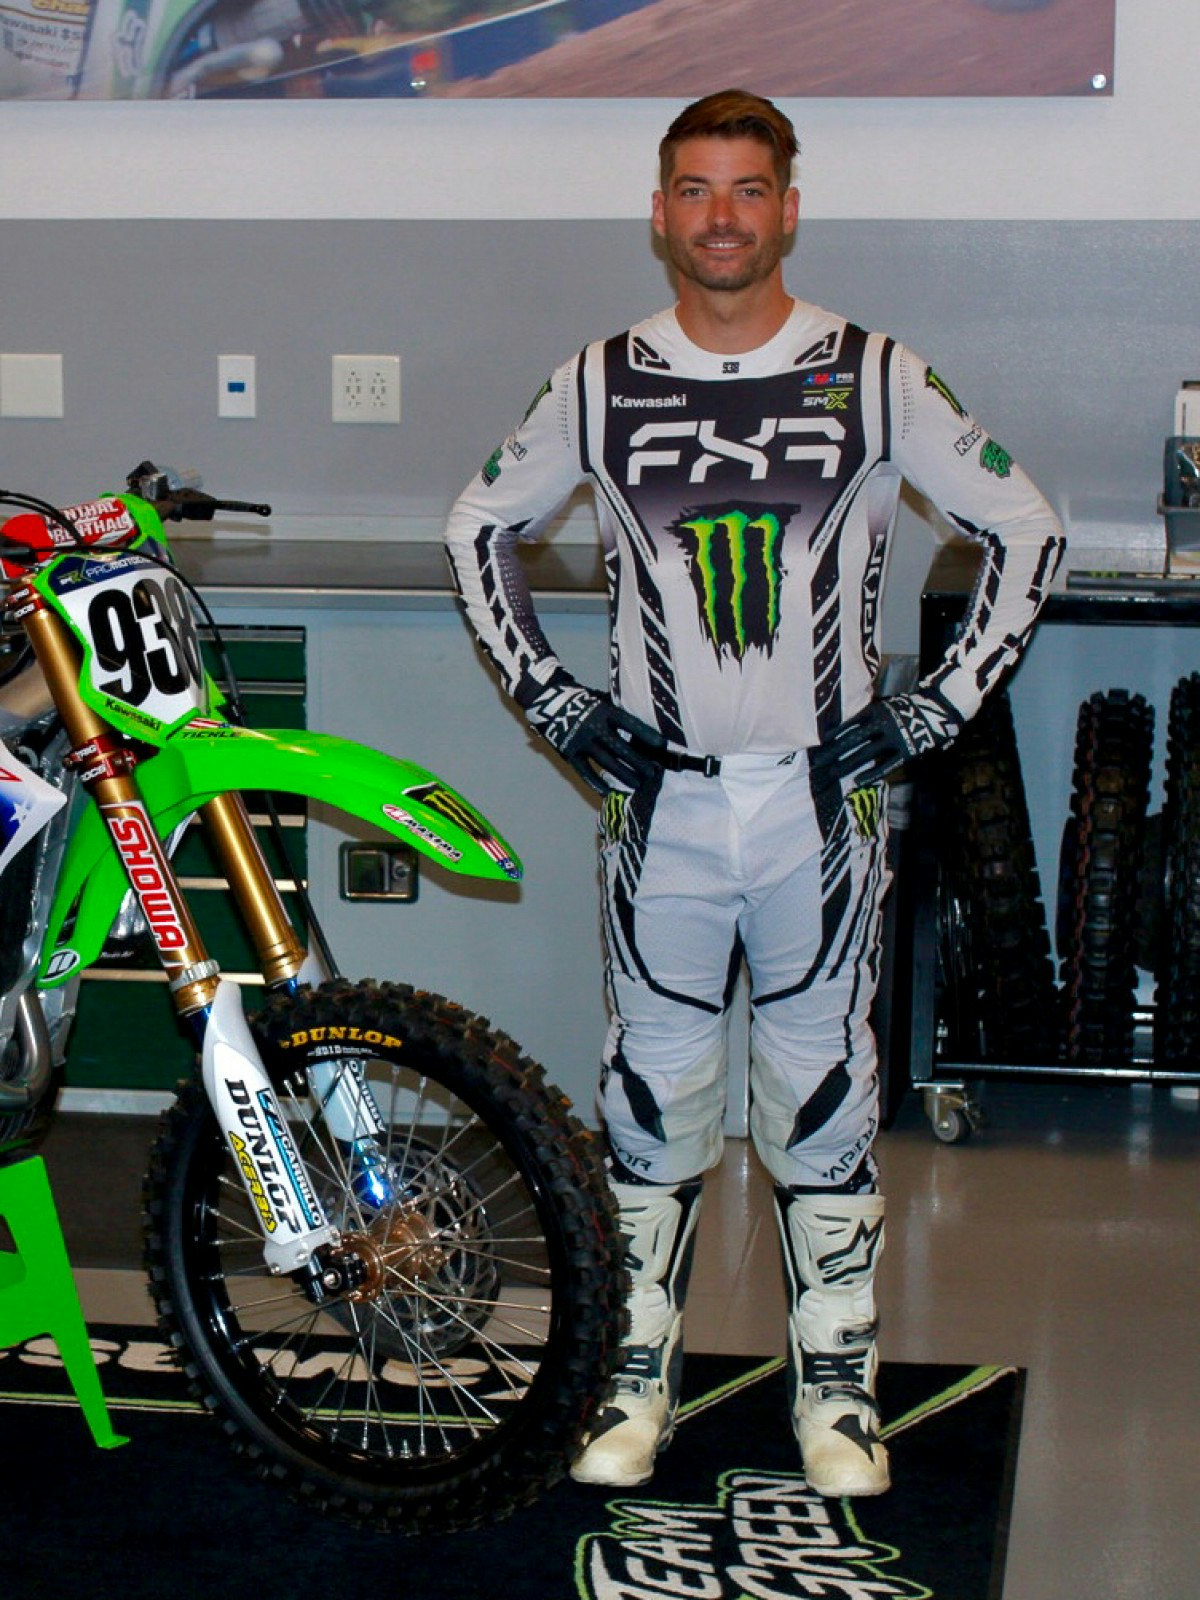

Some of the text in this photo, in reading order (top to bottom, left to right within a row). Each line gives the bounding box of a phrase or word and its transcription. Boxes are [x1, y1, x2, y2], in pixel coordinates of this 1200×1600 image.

[611, 393, 687, 408] Kawasaki
[802, 391, 850, 410] SMX
[627, 417, 847, 486] FXR
[88, 577, 203, 707] 938
[104, 698, 162, 732] Kawasaki
[181, 731, 240, 739] TICKLE
[544, 690, 599, 749] FXR
[108, 817, 188, 951] SHOWA
[290, 1025, 402, 1048] DUNLOP
[225, 1078, 301, 1234] DUNLOP
[228, 1130, 278, 1234] ACERBIS
[282, 1135, 322, 1227] CARRILLO
